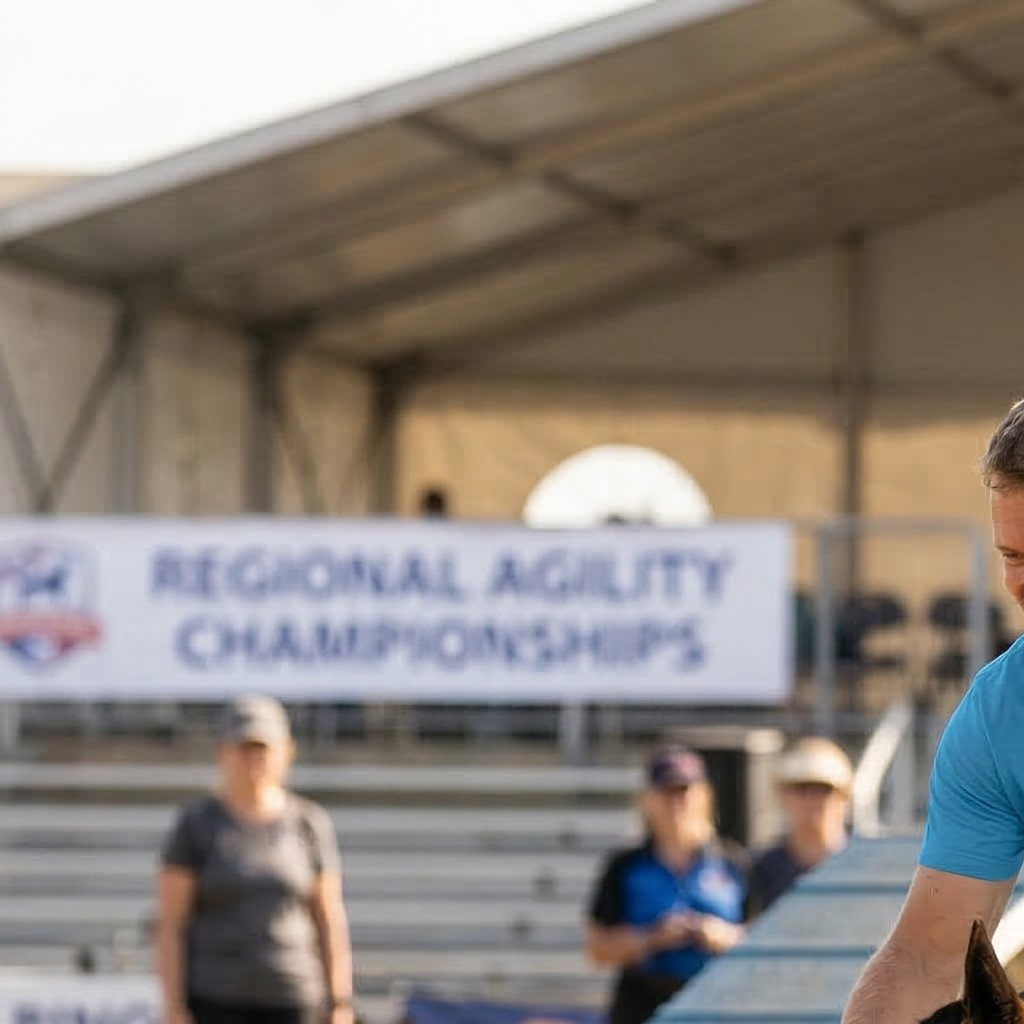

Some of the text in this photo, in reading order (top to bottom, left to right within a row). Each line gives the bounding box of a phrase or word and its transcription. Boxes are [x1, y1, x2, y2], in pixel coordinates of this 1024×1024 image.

[149, 548, 734, 600] REGIONAL AGILITY
[174, 616, 708, 670] CHAMPIONSHIPS
